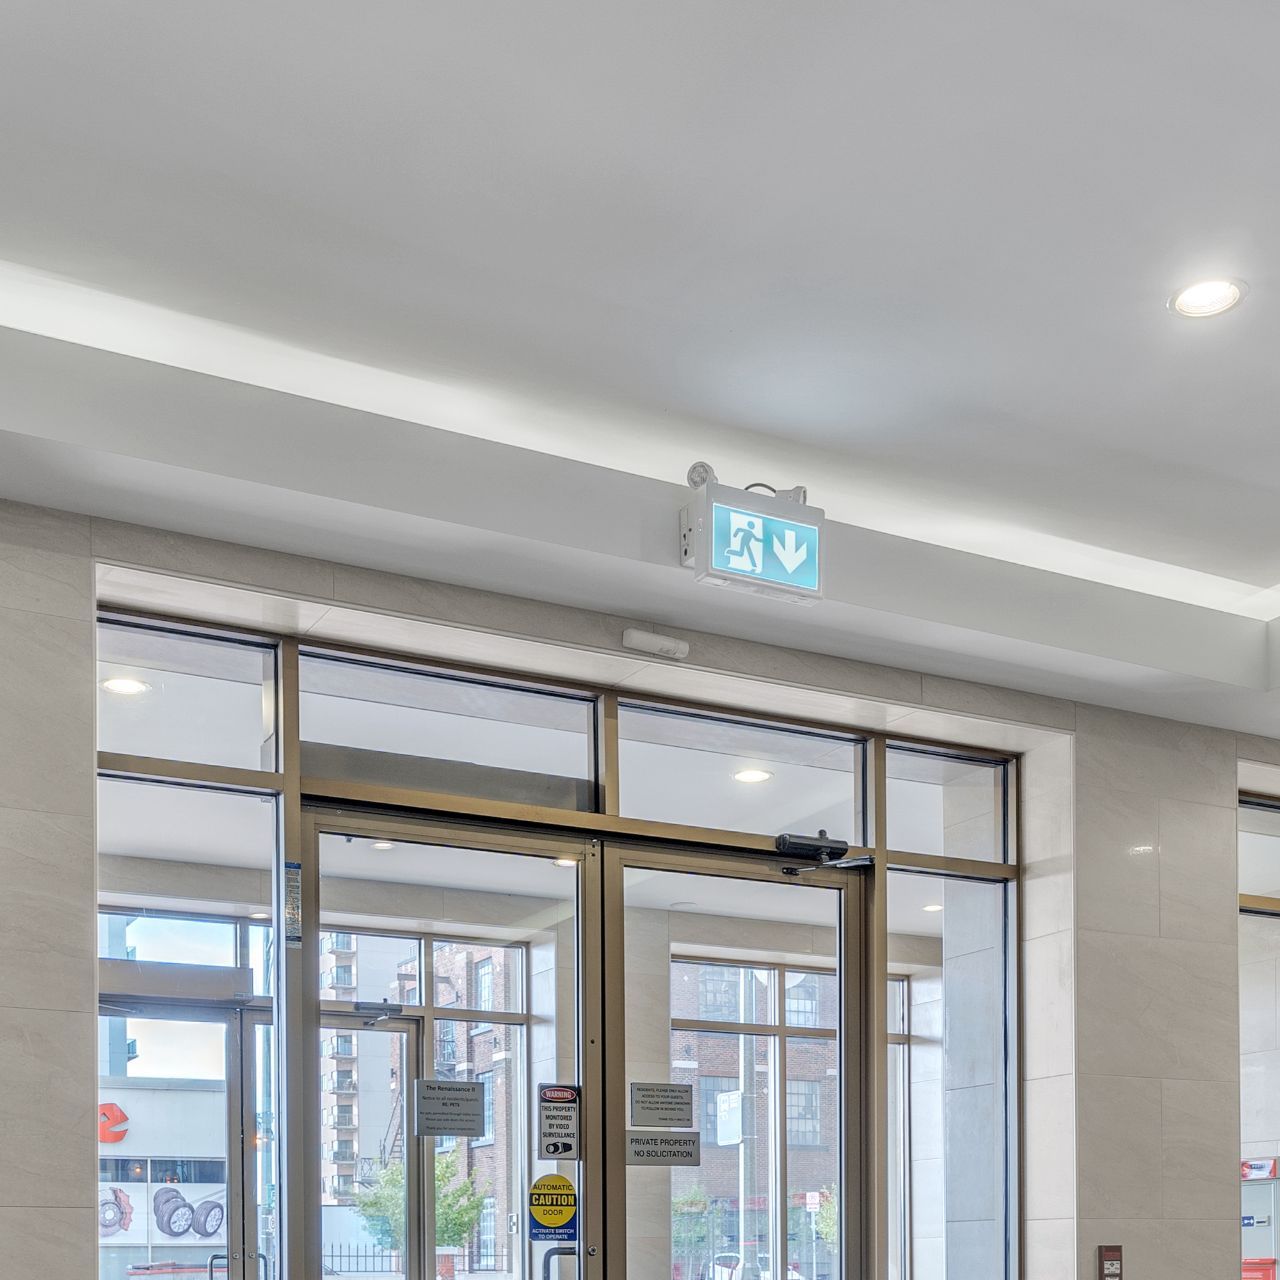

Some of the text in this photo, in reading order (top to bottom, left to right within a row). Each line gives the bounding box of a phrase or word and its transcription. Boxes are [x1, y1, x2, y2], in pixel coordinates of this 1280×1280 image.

[545, 1090, 572, 1099] WARNING
[542, 1131, 576, 1139] SURVEILLANCE
[630, 1138, 696, 1147] PRIVATE PROPERTY
[646, 1150, 693, 1158] SOLICITATION
[532, 1183, 575, 1191] AUTOMATIC
[532, 1194, 575, 1206] CAUTION
